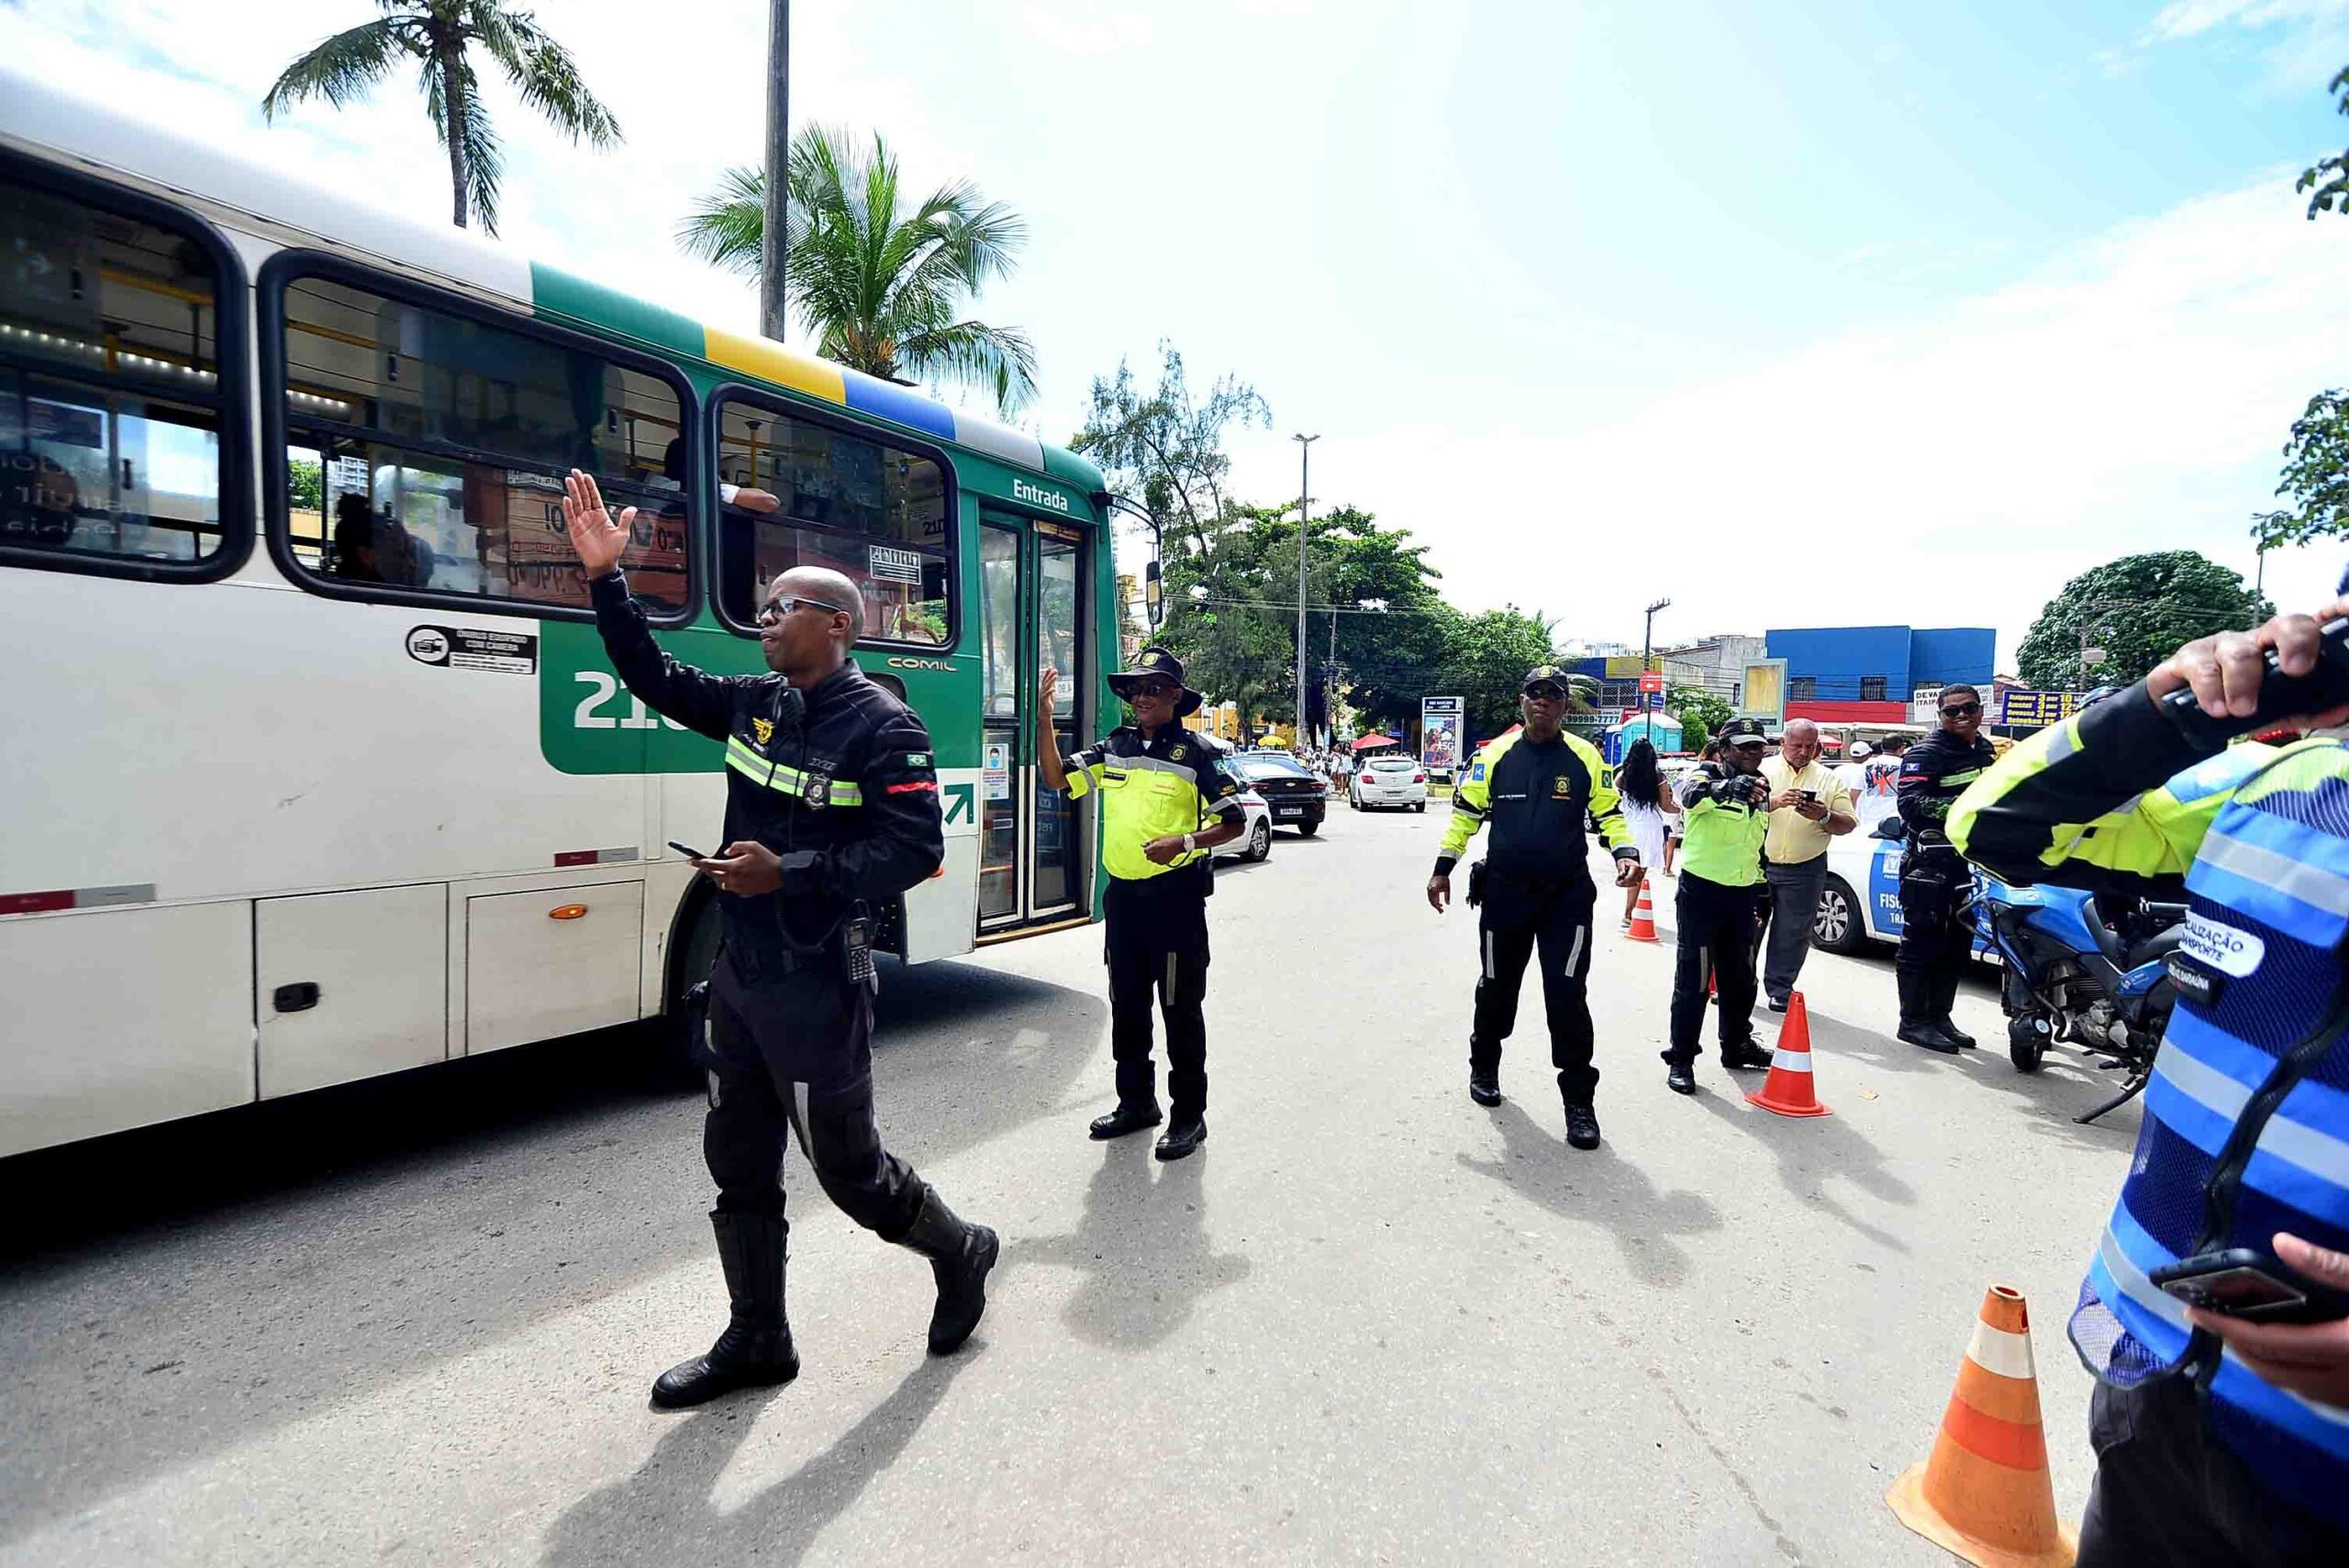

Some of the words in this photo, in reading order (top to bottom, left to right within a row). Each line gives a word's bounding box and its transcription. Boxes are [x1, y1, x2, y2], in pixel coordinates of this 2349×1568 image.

[1013, 479, 1068, 511] Entrada
[887, 657, 957, 672] COMIL
[574, 671, 689, 730] 21
